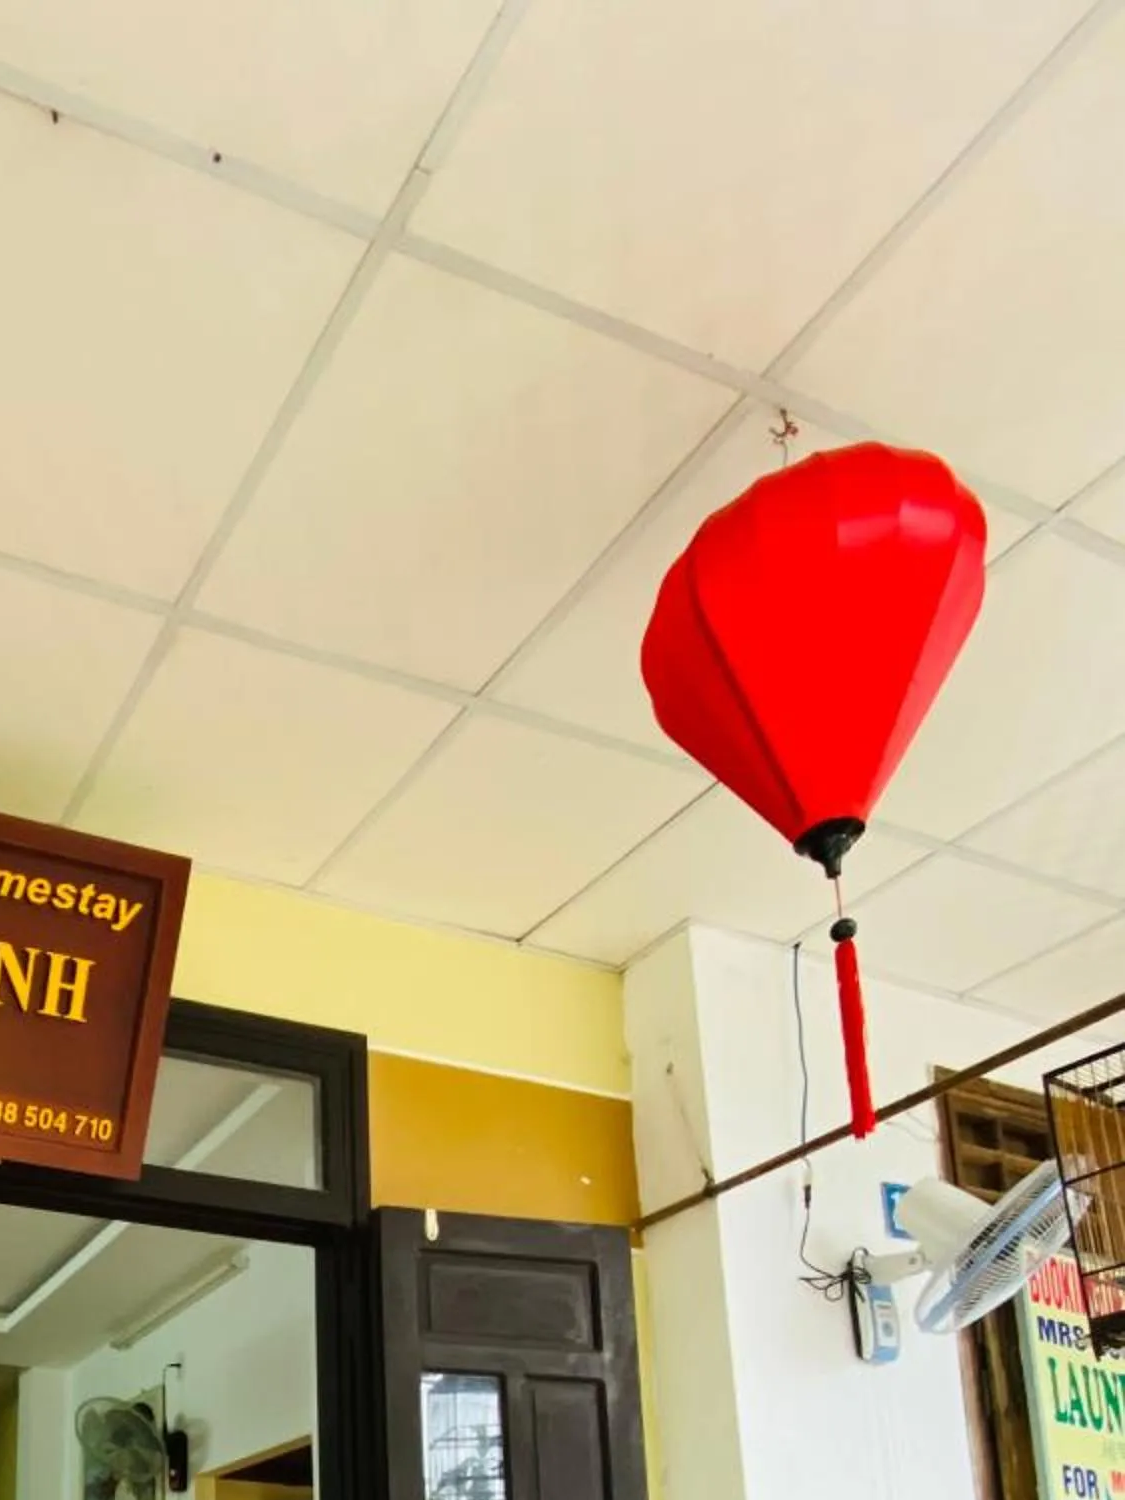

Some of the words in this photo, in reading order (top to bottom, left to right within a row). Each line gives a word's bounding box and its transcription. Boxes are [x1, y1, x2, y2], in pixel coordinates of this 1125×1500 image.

[24, 1105, 68, 1133] 504
[74, 1115, 113, 1141] 710
[1062, 1465, 1100, 1499] FOR
